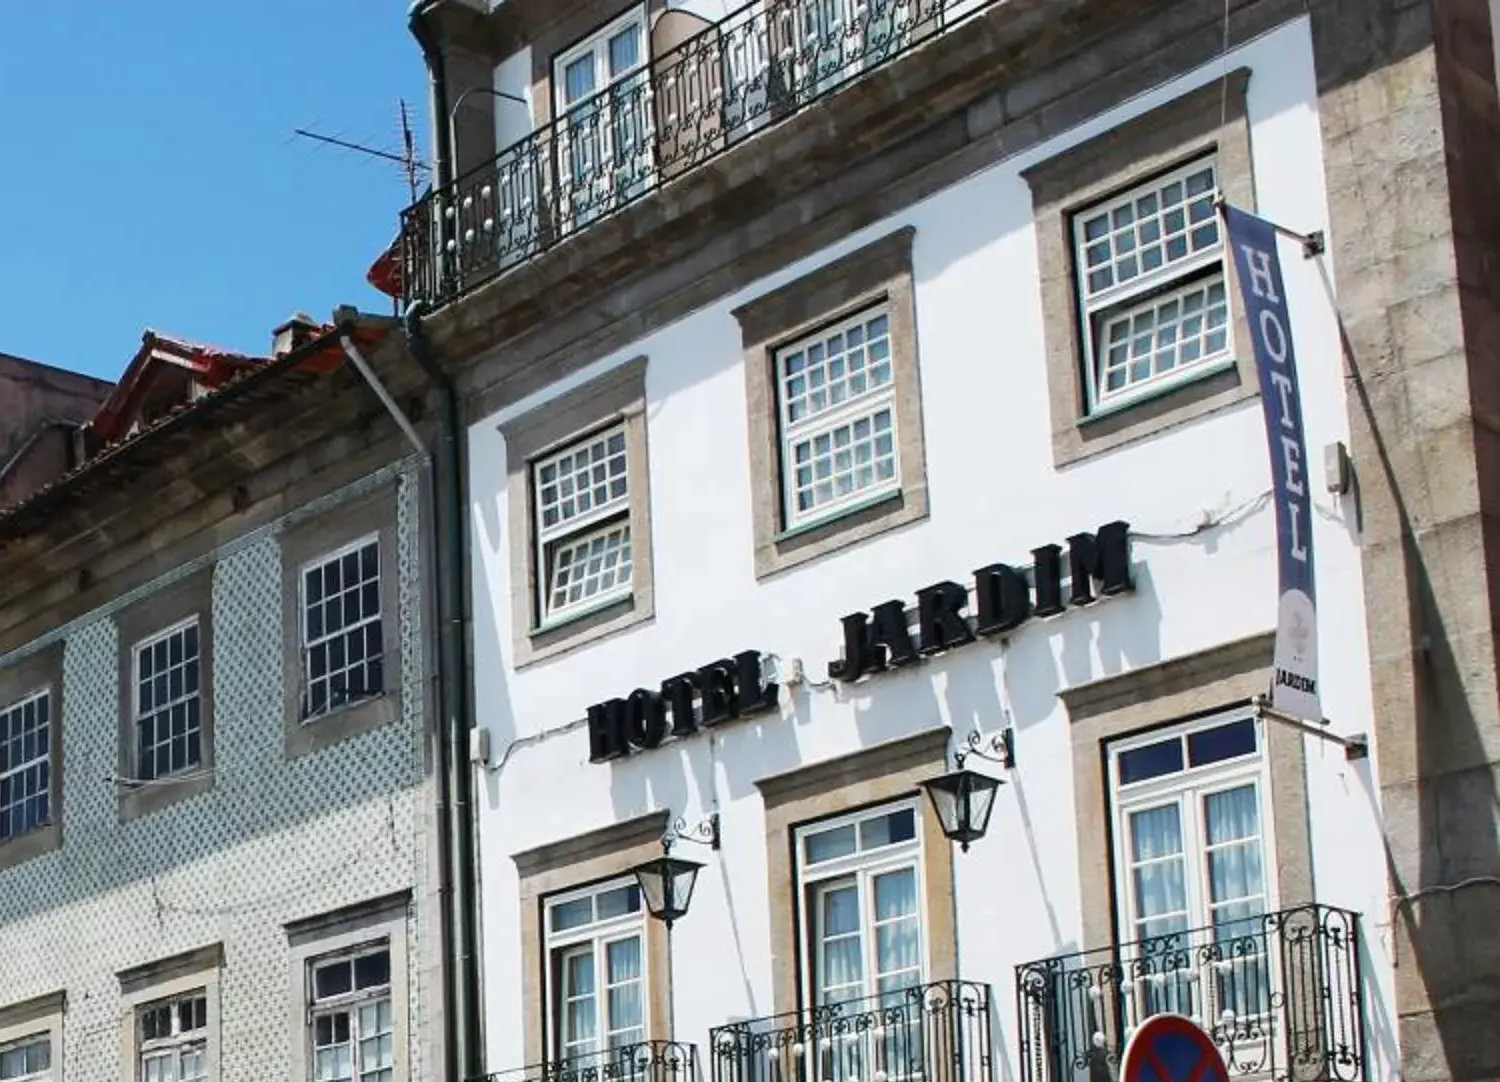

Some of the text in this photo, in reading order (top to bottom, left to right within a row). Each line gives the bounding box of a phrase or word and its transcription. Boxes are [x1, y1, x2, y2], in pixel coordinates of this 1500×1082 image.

[1240, 244, 1309, 564] HOTEL
[587, 519, 1138, 764] HOTEL JARDIM
[1275, 666, 1318, 696] JARDIM
